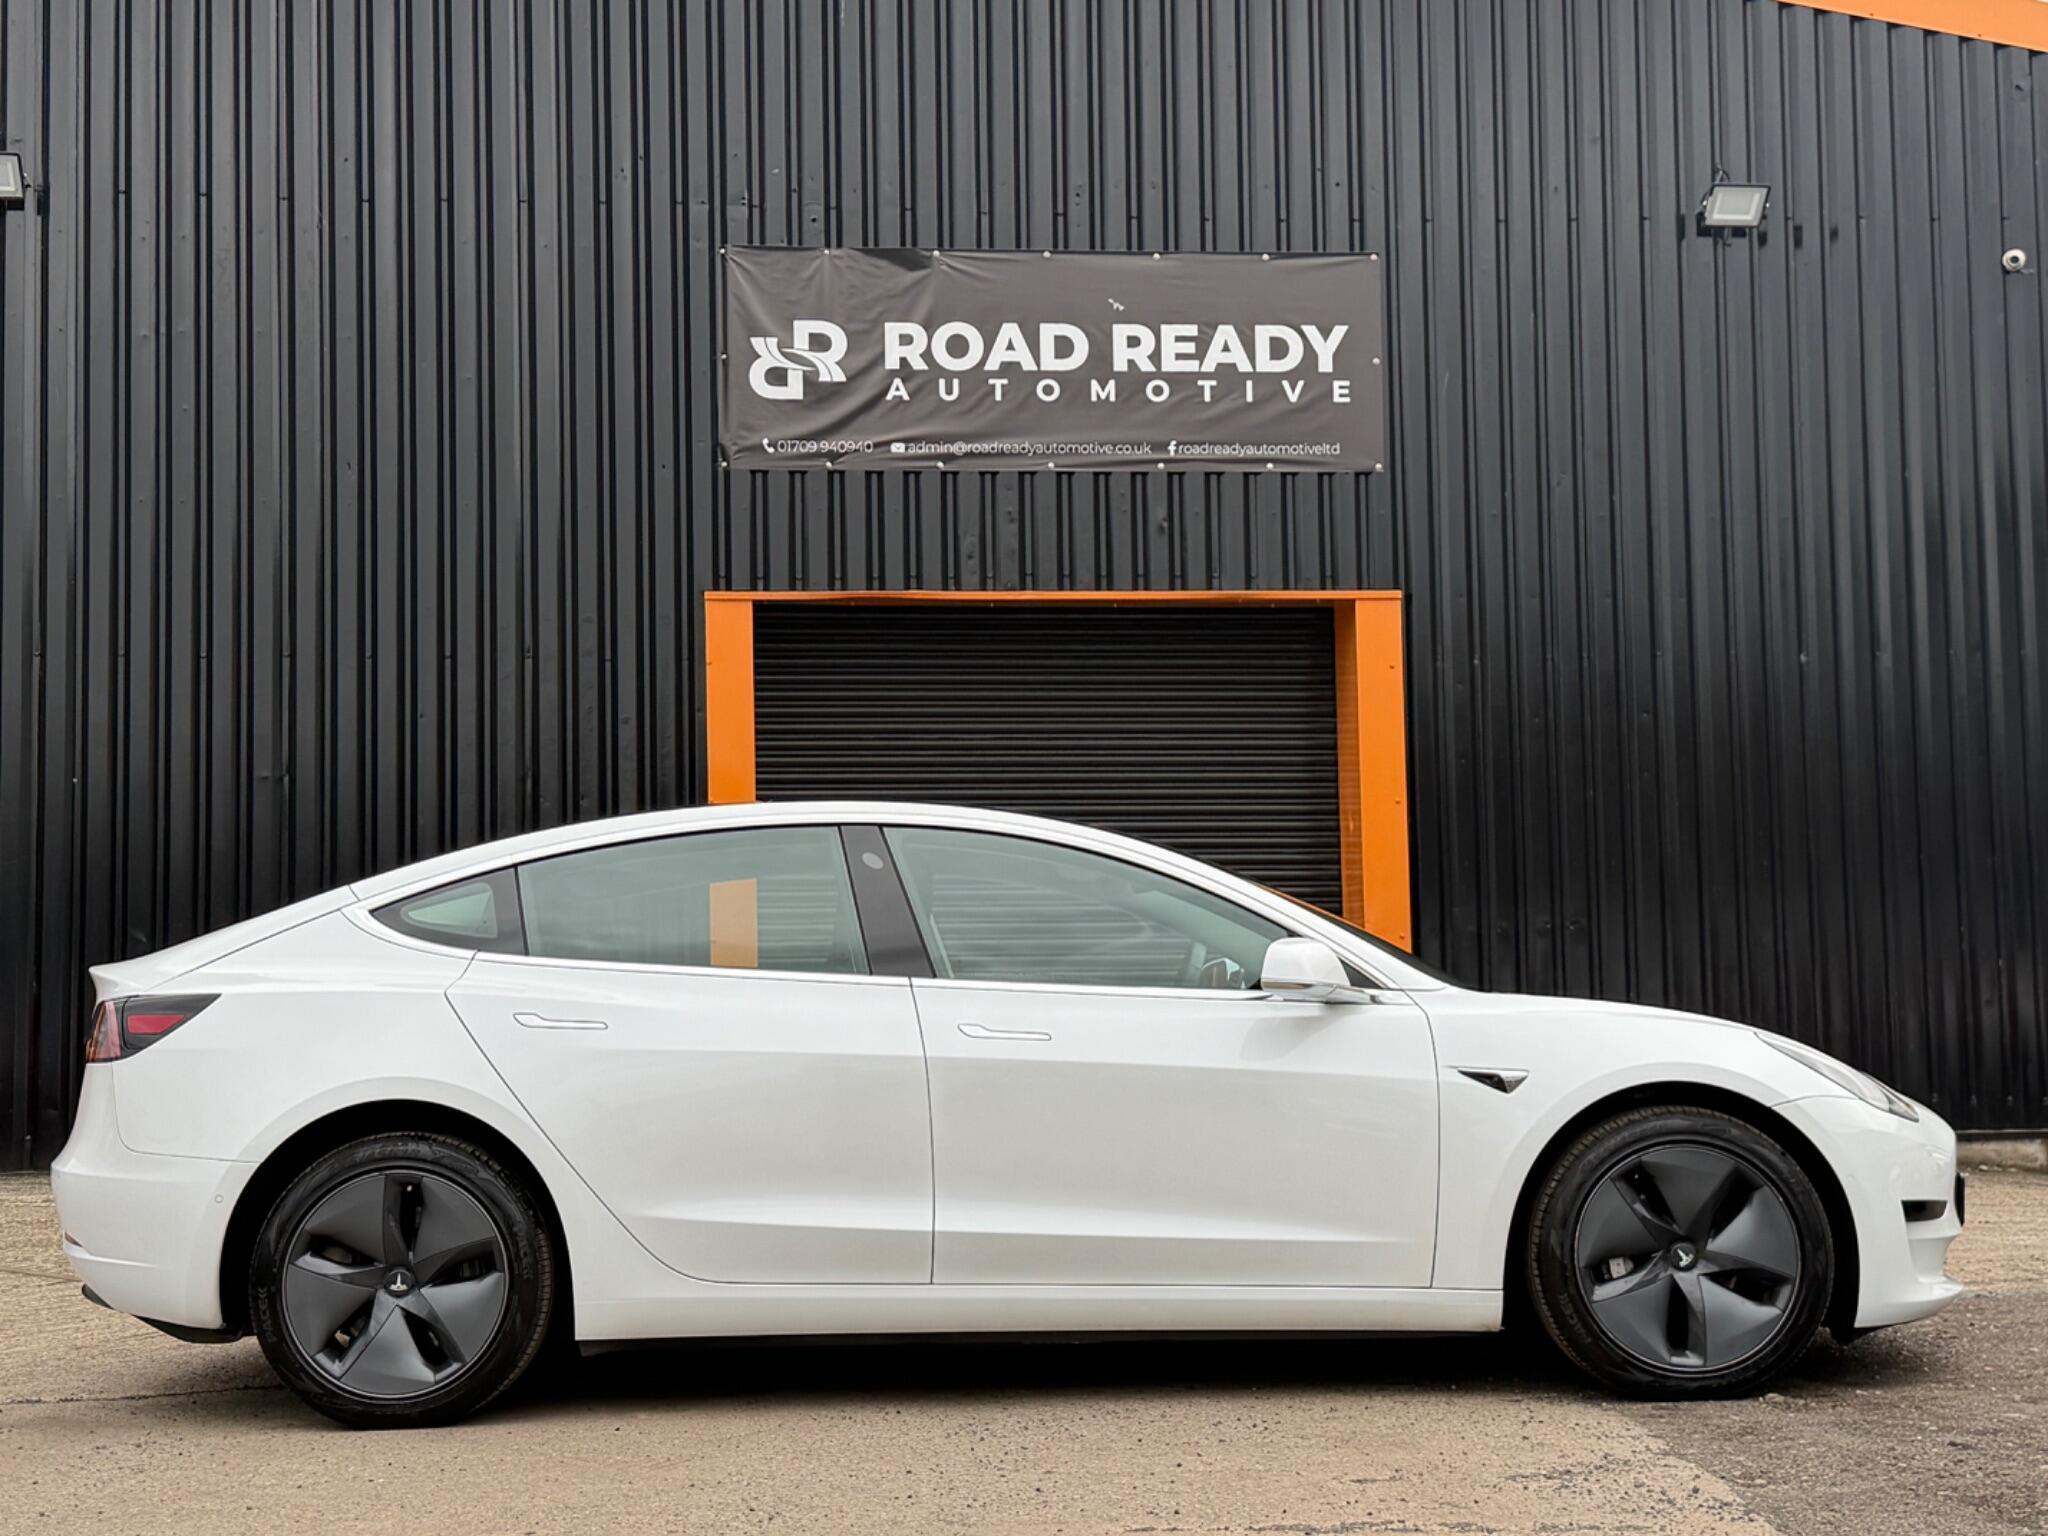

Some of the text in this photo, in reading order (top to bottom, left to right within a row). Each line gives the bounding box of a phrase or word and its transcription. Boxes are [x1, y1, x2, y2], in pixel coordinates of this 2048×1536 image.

[884, 321, 1349, 373] ROAD READY
[886, 377, 1351, 403] AUTOMOTIVE
[777, 439, 873, 453] 01709 940940
[908, 439, 1152, 458] admin@roadreadyautomotive.co.uk
[1178, 442, 1341, 458] roadreadyautomotiveltd
